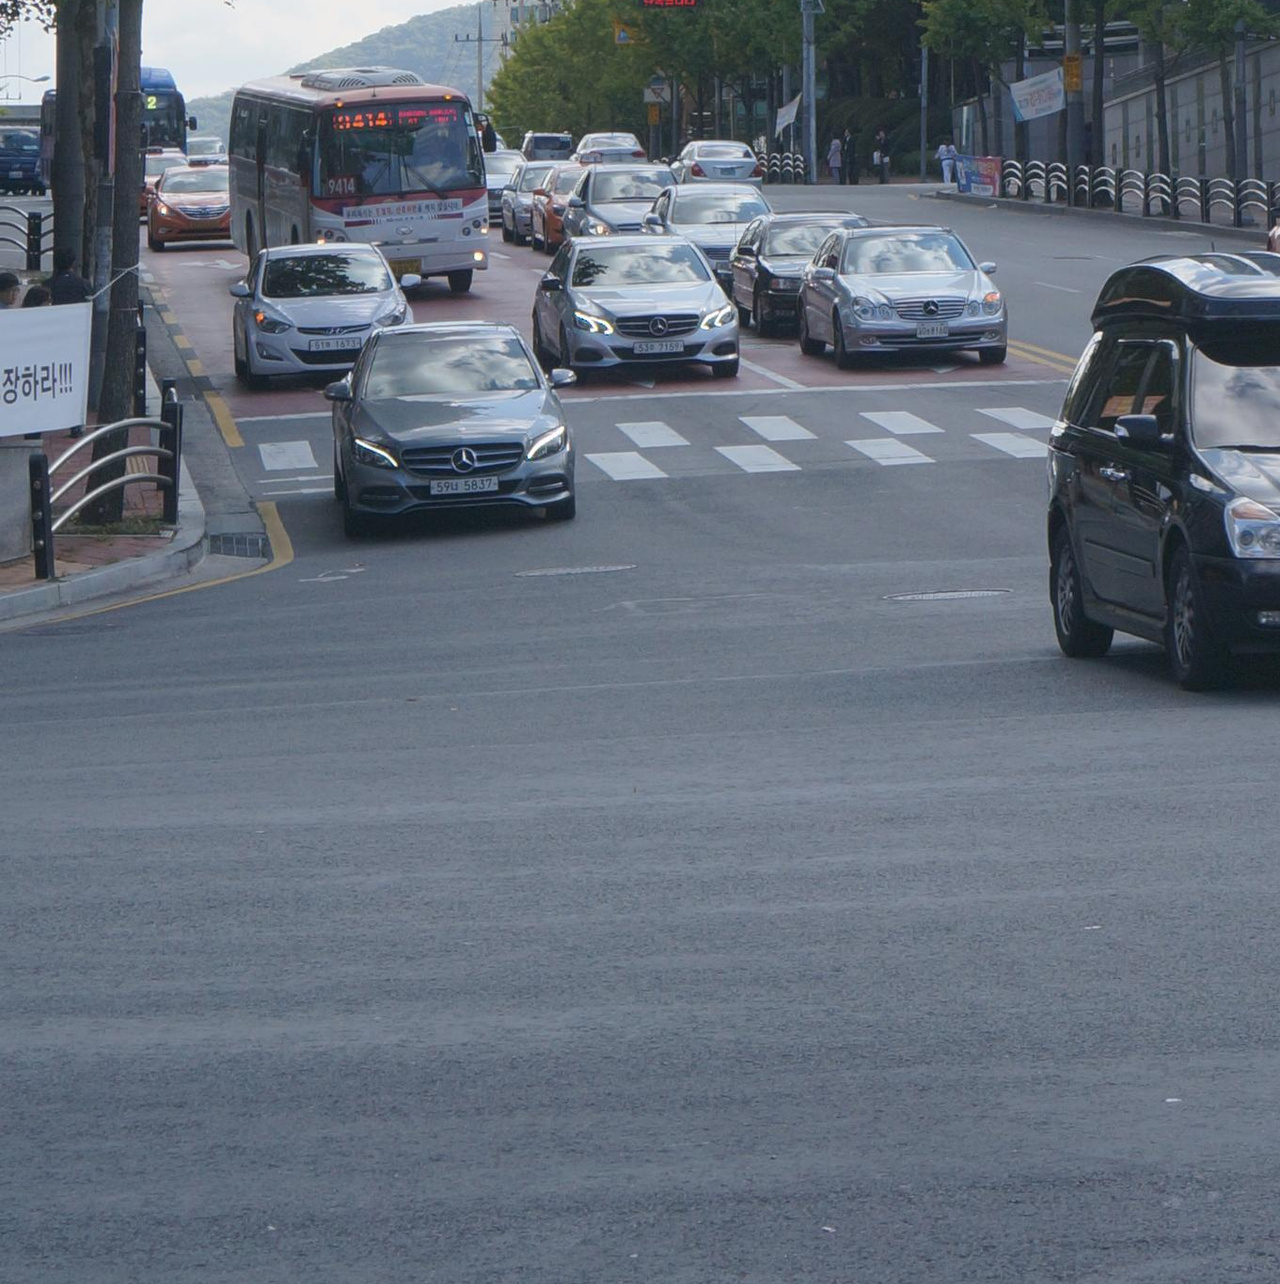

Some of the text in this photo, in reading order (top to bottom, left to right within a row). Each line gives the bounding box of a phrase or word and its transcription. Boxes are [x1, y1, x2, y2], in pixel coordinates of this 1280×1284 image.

[328, 177, 355, 195] 9414
[2, 362, 73, 405] 장하라!!!
[464, 478, 492, 491] 5837
